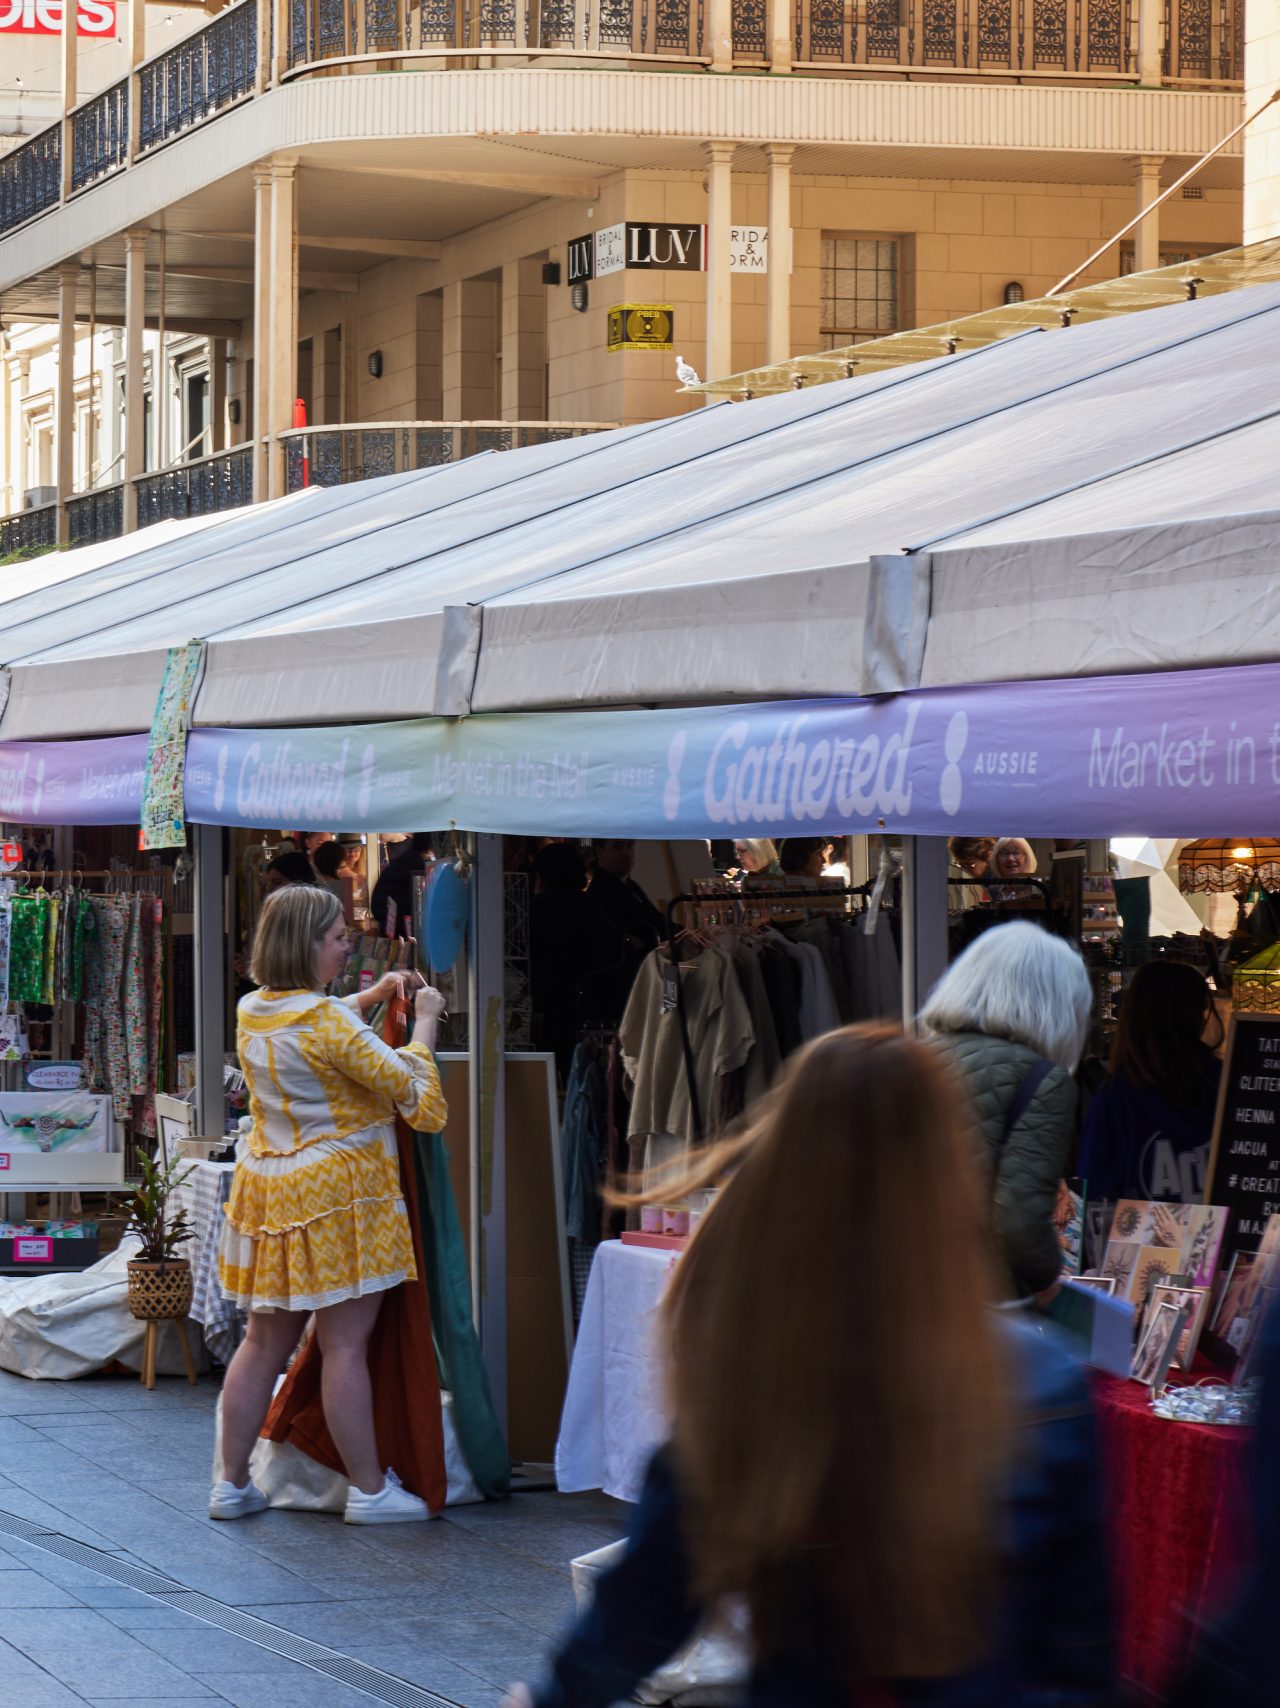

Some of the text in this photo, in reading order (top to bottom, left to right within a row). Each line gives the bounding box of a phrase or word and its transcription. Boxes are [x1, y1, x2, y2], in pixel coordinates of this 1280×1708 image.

[598, 232, 622, 247] BRIDAL
[629, 228, 697, 264] LUV
[746, 244, 756, 256] &
[569, 239, 592, 280] LUV
[597, 255, 624, 268] FORMAL
[705, 704, 913, 826] Gathered
[974, 751, 1038, 775] AUSSIE
[1088, 722, 1215, 789] Market
[1227, 720, 1256, 785] in
[378, 771, 413, 787] AUSSIE
[431, 752, 493, 797] Market
[612, 768, 656, 787] AUSSIE
[1235, 1107, 1275, 1124] HENNA
